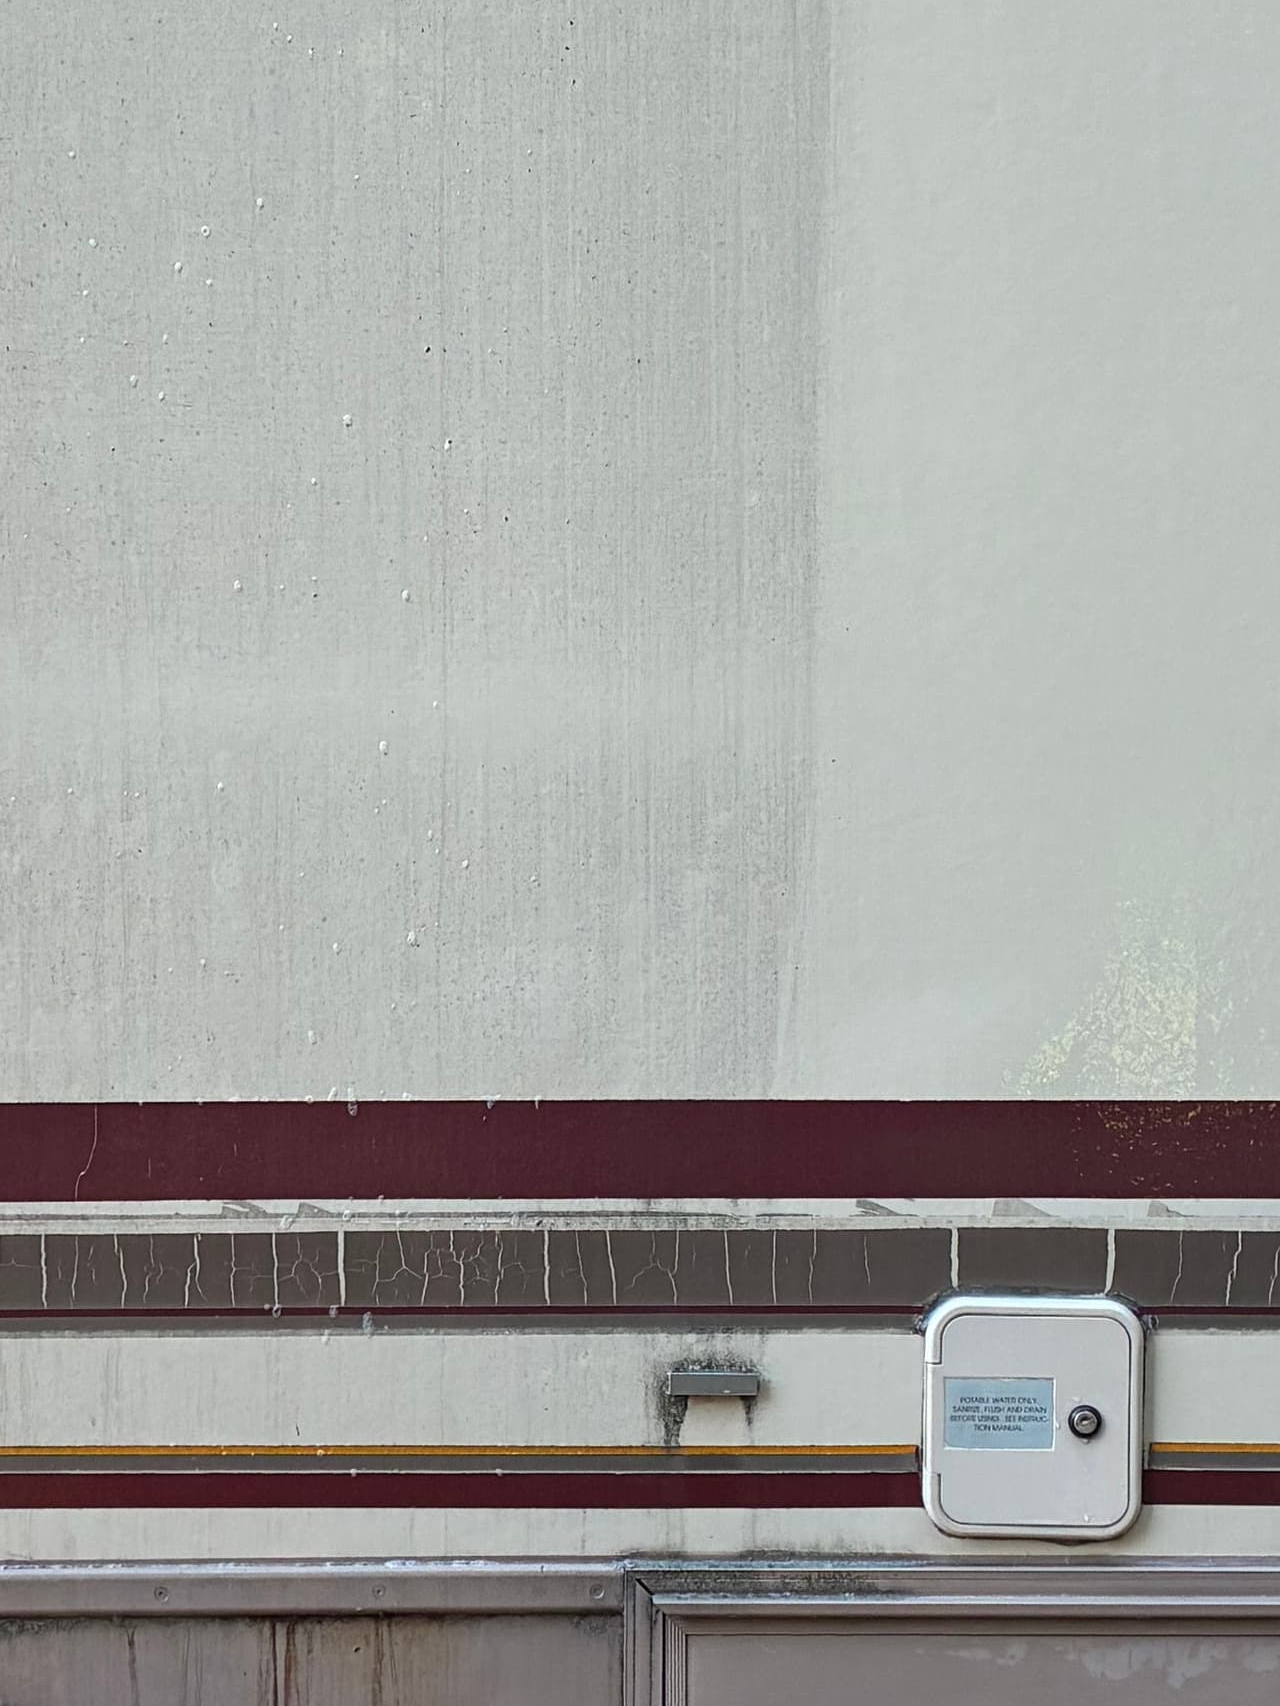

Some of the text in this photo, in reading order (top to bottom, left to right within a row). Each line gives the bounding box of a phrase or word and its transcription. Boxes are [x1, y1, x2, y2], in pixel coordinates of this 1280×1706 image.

[959, 1396, 989, 1404] POTABLE
[992, 1396, 1016, 1404] WATER
[1024, 1406, 1047, 1414] DRAIN
